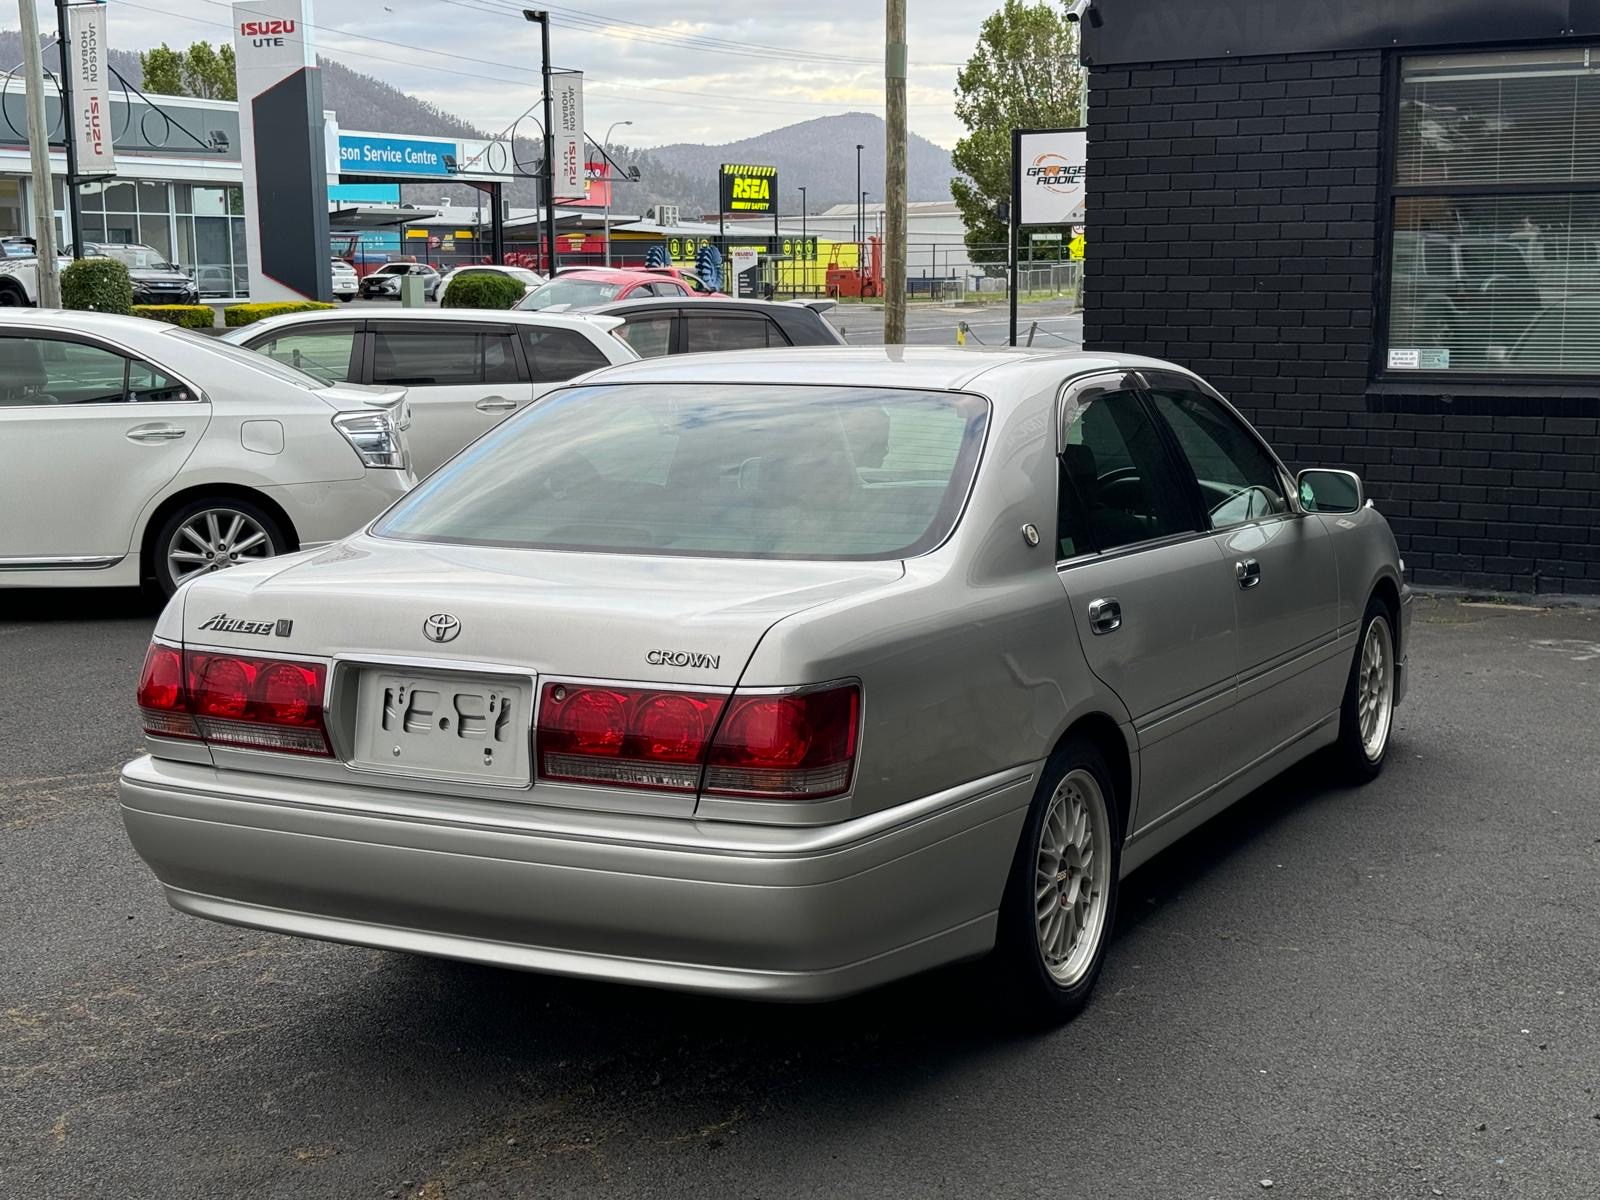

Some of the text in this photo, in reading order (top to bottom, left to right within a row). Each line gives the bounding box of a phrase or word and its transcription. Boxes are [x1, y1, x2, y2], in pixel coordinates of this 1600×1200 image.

[240, 19, 295, 36] ISUZU
[253, 37, 284, 48] UTE
[80, 31, 90, 83] HOBART
[88, 22, 98, 83] JACKSON
[84, 109, 92, 144] UTE
[90, 96, 103, 156] ISUZU
[561, 91, 570, 132] HOBART
[568, 85, 576, 131] JACKSON
[363, 144, 402, 163] Service
[405, 147, 438, 165] Centre
[568, 141, 577, 186] ISUZU
[733, 178, 769, 199] RSEA
[645, 649, 721, 670] CROWN
